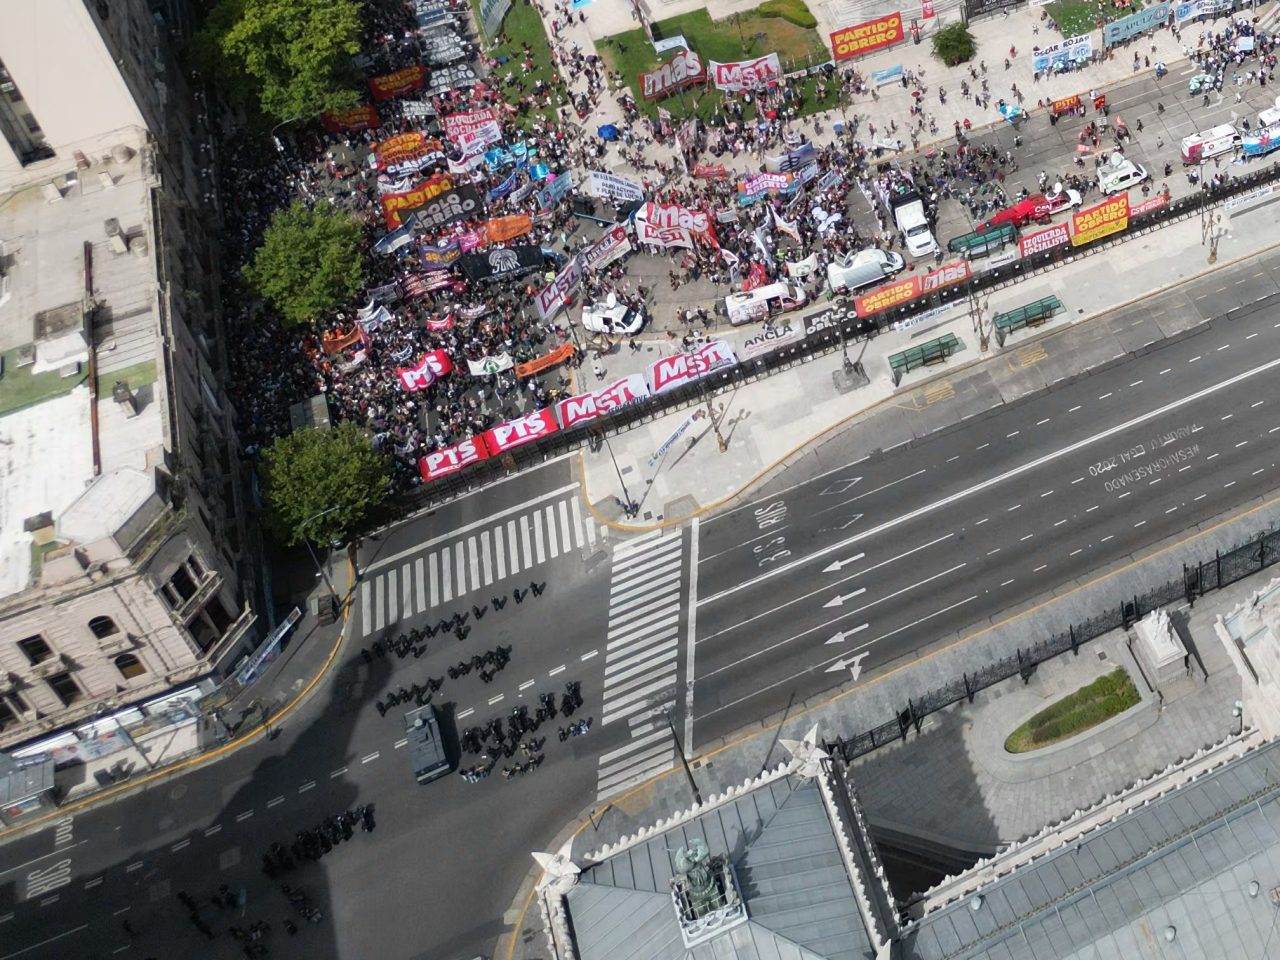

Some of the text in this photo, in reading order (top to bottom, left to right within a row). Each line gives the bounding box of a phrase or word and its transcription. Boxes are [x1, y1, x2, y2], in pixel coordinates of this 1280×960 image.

[834, 16, 900, 43] PARTIDO
[837, 28, 897, 55] OBRERO
[429, 70, 475, 88] OBRERO
[431, 64, 468, 78] POLO
[647, 51, 702, 93] mas
[719, 61, 773, 85] MST
[1055, 96, 1079, 109] PSTU
[446, 110, 493, 128] IZQUIERDA
[386, 150, 446, 174] CLASISTA
[384, 178, 452, 212] PARTIDO
[416, 193, 460, 219] POLO
[651, 204, 710, 233] mas
[1075, 197, 1127, 225] PARTIDO
[1078, 208, 1127, 232] OBRERO
[1022, 227, 1067, 248] IZQUIERDA
[1023, 234, 1070, 257] SOCIALISTA
[861, 281, 914, 307] PARTIDO
[864, 289, 913, 313] OBRERO
[743, 323, 793, 349] ANCLA
[401, 355, 442, 389] PTS
[660, 348, 723, 382] MST
[566, 381, 635, 422] MST
[493, 412, 546, 445] PTS
[425, 439, 477, 472] PTS
[26, 858, 72, 899] BUS
